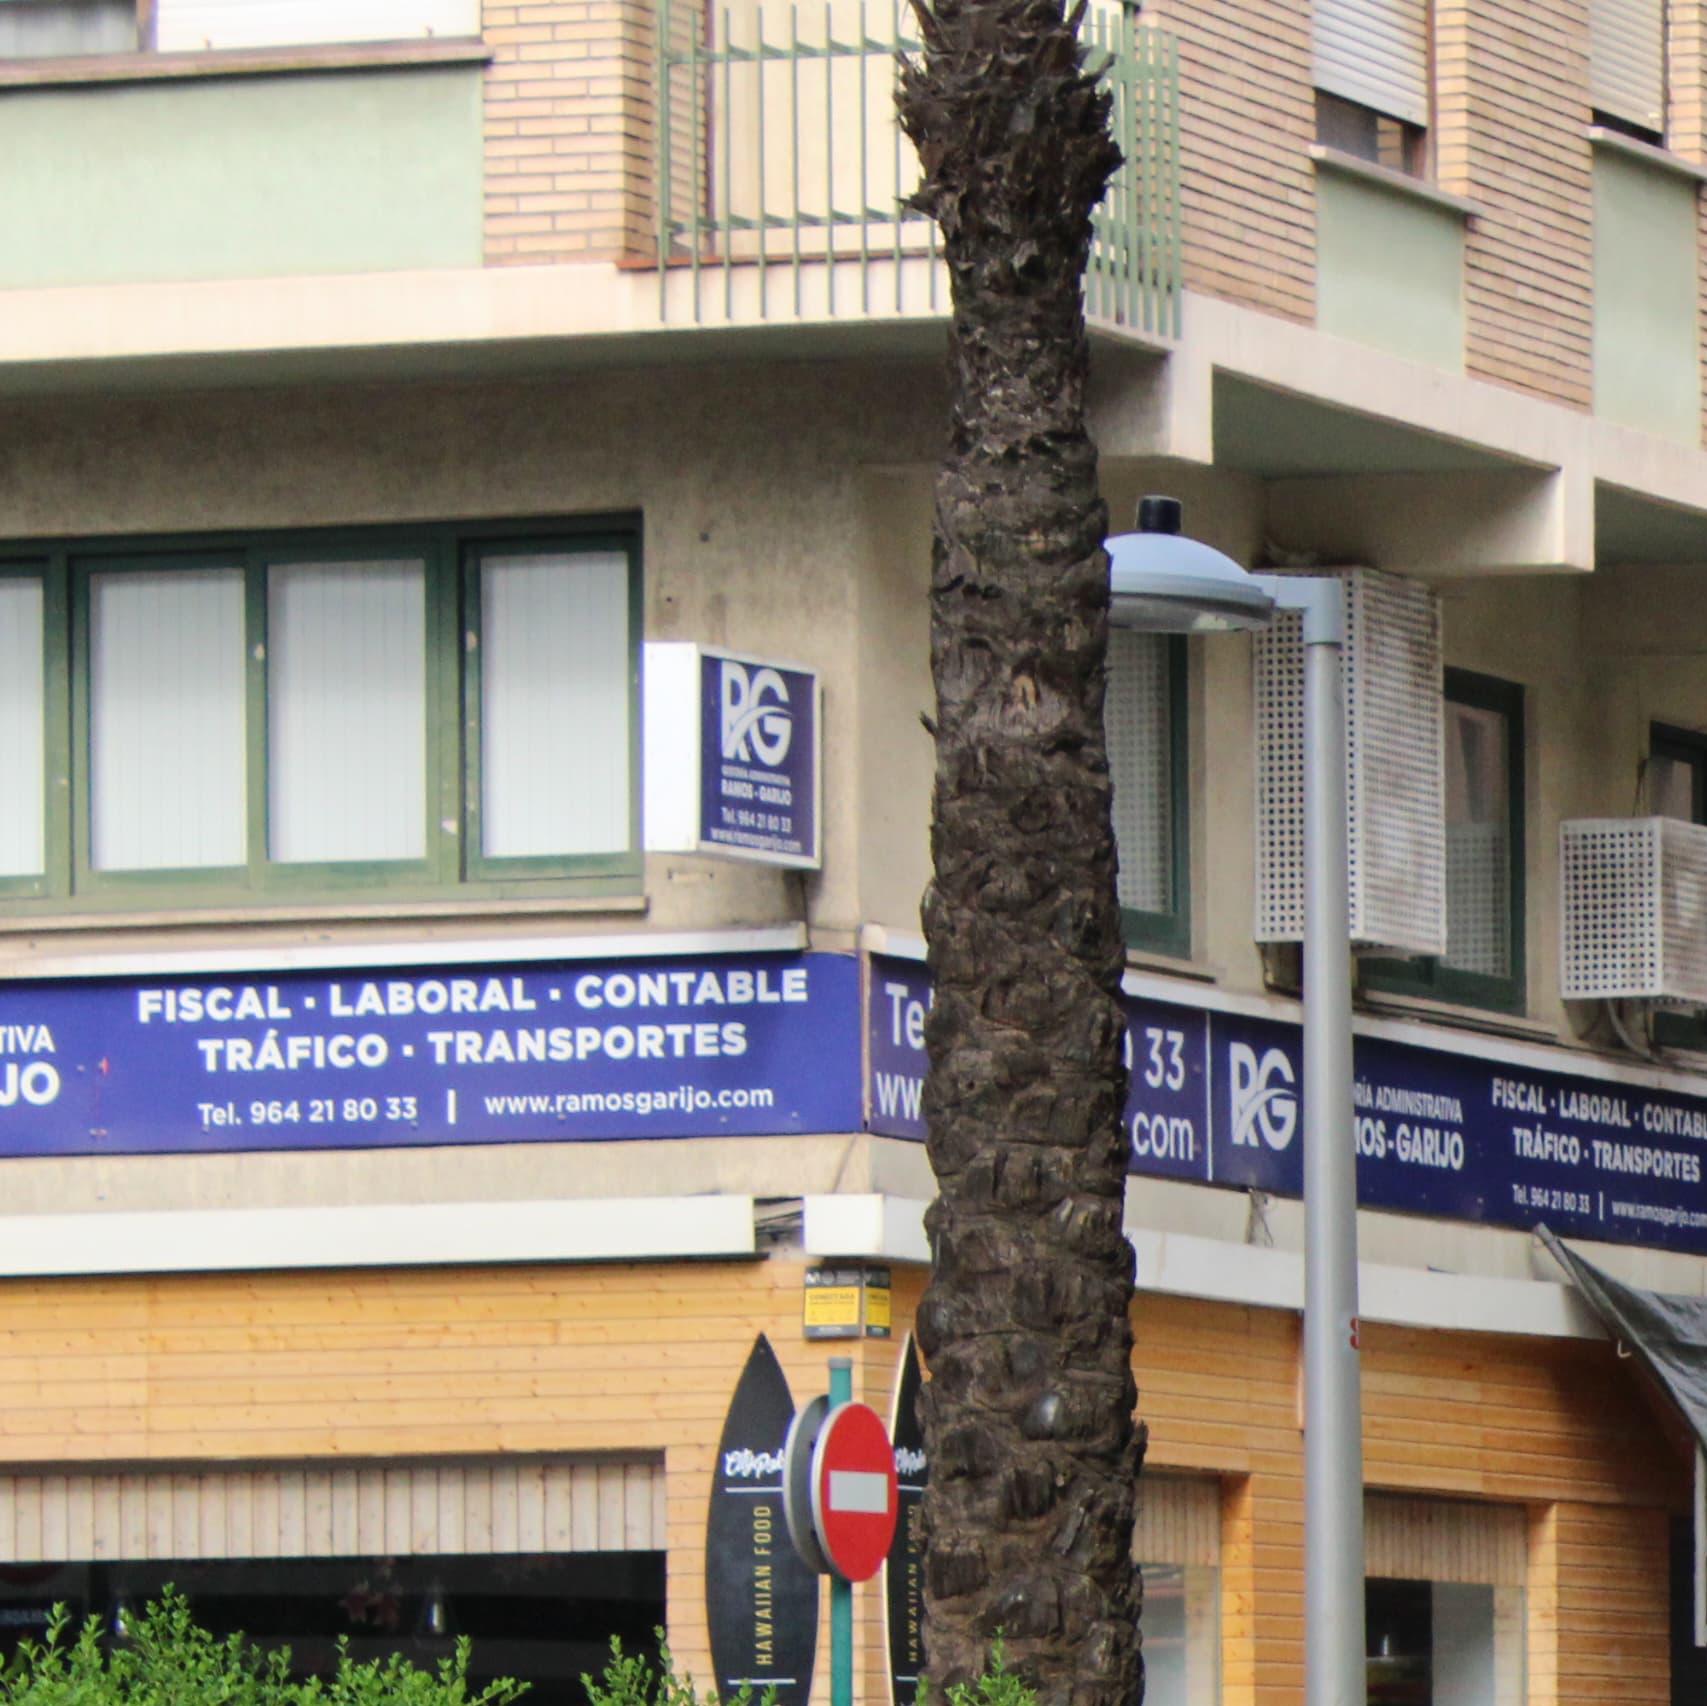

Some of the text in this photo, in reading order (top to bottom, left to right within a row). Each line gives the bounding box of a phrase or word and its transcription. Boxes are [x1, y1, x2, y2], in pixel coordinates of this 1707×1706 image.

[721, 660, 794, 767] RG
[137, 969, 808, 1022] FISCAL LABORAL CONTABLE
[885, 981, 935, 1050] Te
[198, 1022, 747, 1072] TRÁFICO TRANSPORTES
[1144, 1027, 1186, 1091] 33
[198, 1085, 774, 1126] Tel. 964 21 80 33 www.ramosgarijo.com
[1229, 1041, 1298, 1151] RG
[1375, 1085, 1463, 1124] ADMINISTRATIVA
[1492, 1078, 1546, 1114] FISCAL
[1559, 1089, 1632, 1128] LABORAL
[1396, 1122, 1465, 1171] GARIJO
[1513, 1123, 1700, 1183] TRÁFICO TRANSPORTES
[1512, 1184, 1528, 1205] Tel.
[1531, 1187, 1549, 1207] 964
[1551, 1190, 1561, 1209] 21
[1563, 1192, 1576, 1212] 80
[1579, 1195, 1590, 1214] 33
[753, 1505, 773, 1666] HAWAIIAN FOOD
